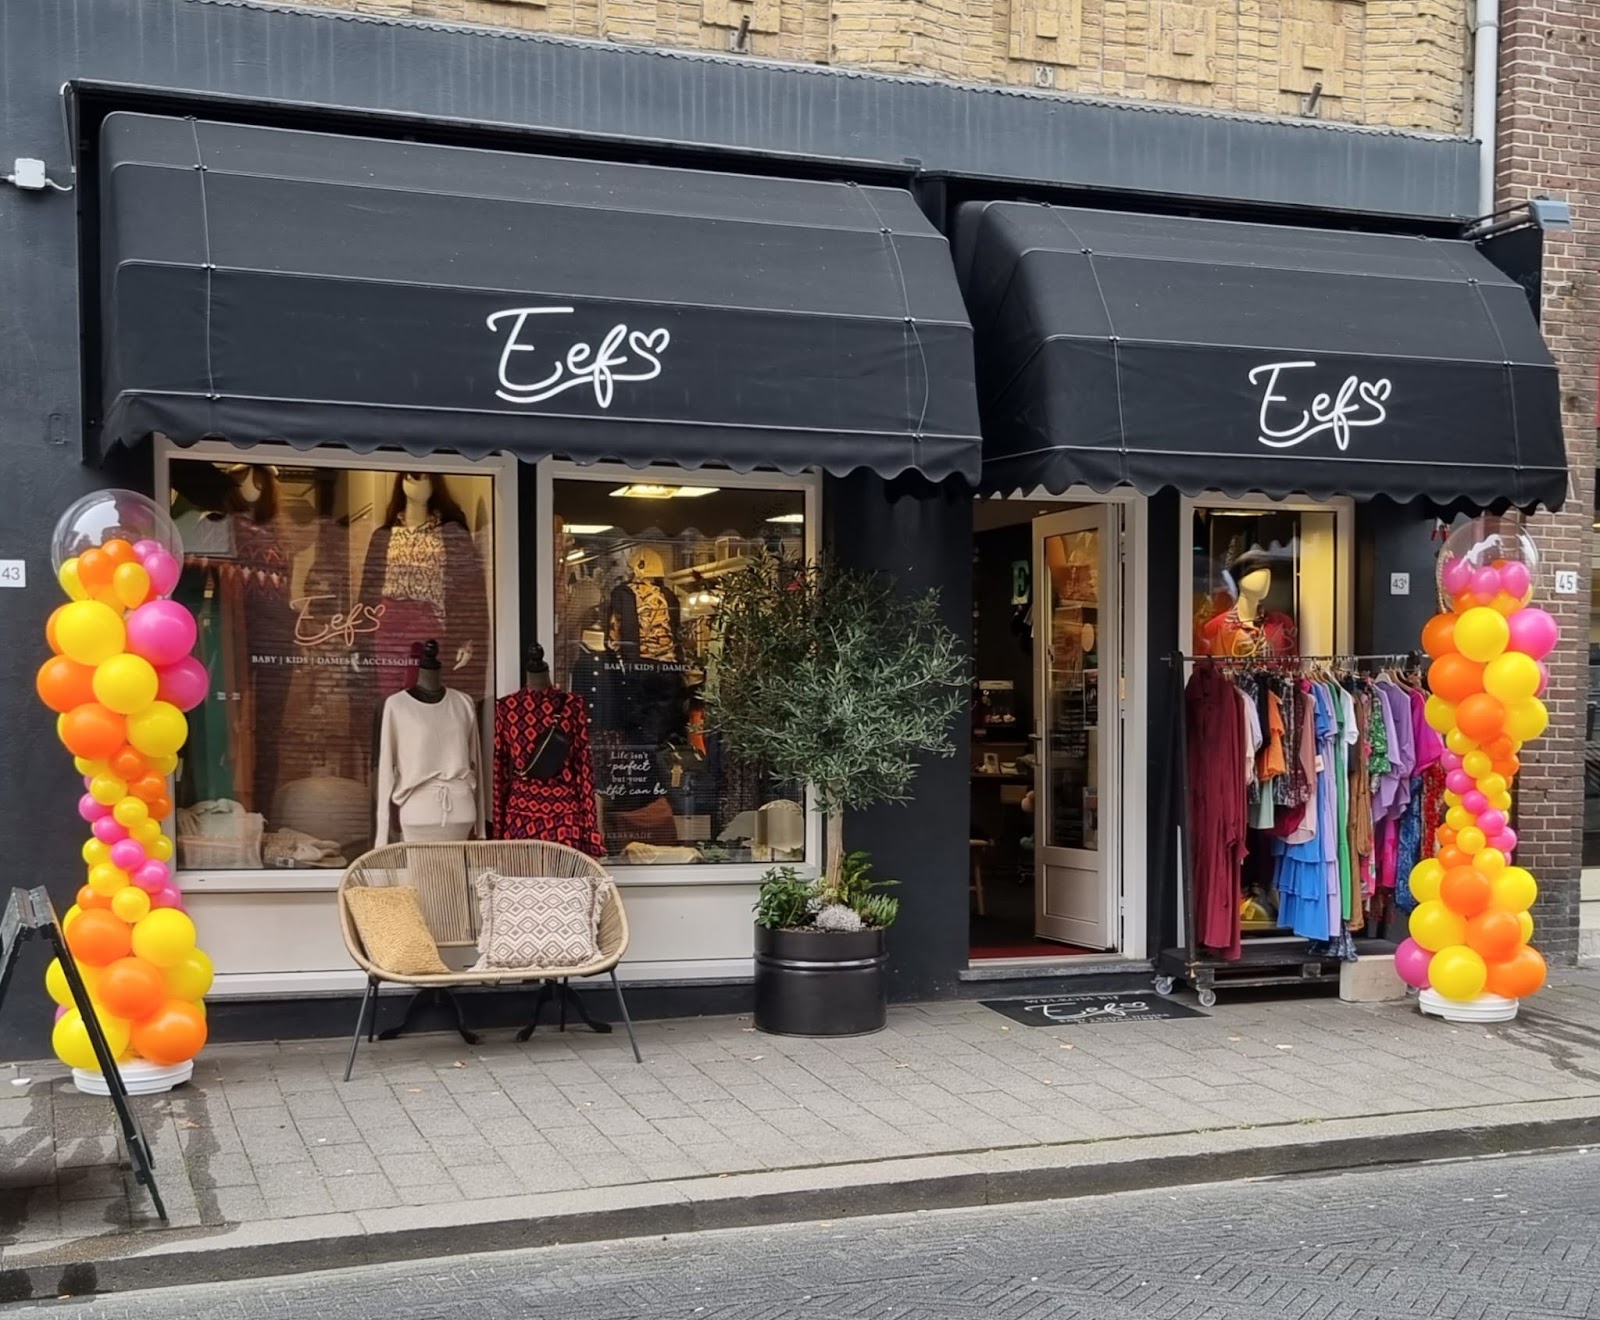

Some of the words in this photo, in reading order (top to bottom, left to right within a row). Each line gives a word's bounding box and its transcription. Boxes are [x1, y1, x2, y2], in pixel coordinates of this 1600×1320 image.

[486, 306, 670, 408] Eefs
[1248, 361, 1391, 451] Eefs
[1, 566, 20, 581] 43
[1559, 574, 1573, 590] 45
[289, 594, 386, 647] Eefs
[252, 654, 277, 664] BABY
[285, 655, 309, 665] KIDS
[317, 656, 351, 666] DAMES
[363, 657, 420, 667] ACCESSOIRE
[634, 663, 655, 672] KIDS
[662, 663, 693, 673] DAMES
[610, 751, 628, 760] Life
[607, 759, 651, 776] perfect
[628, 788, 651, 796] can
[653, 782, 668, 796] be
